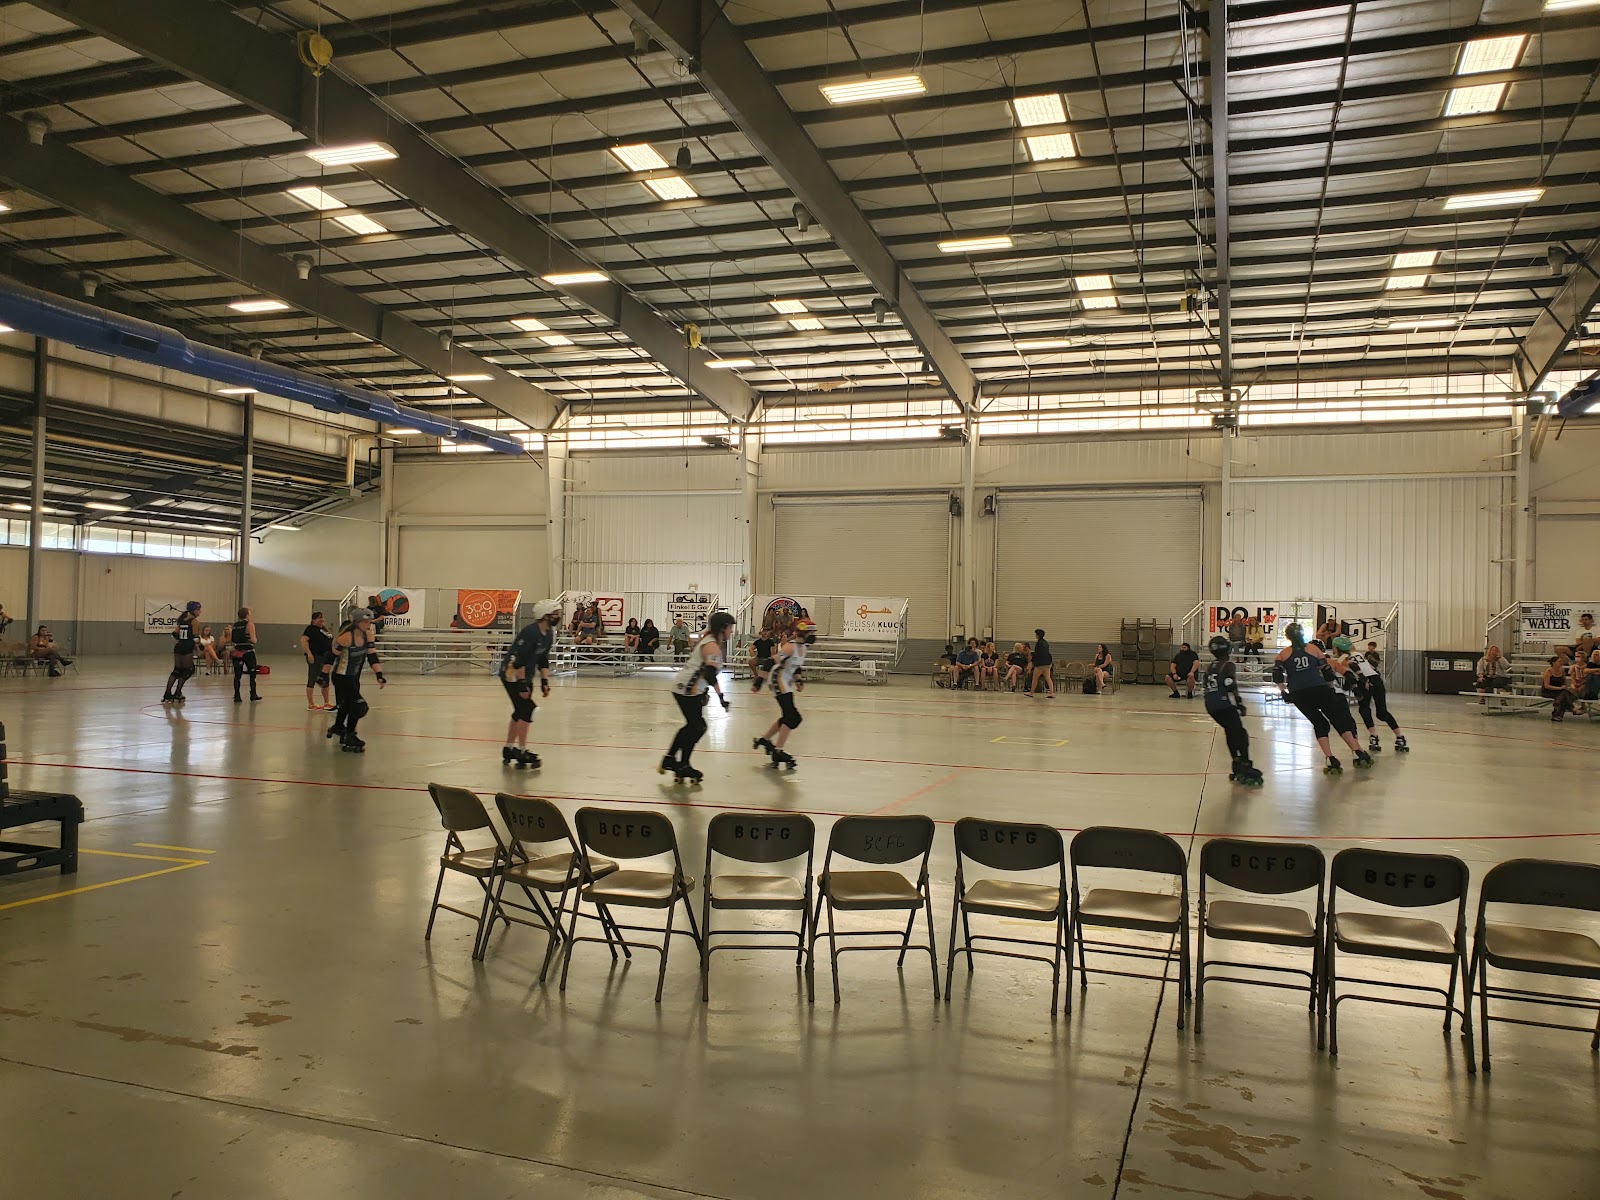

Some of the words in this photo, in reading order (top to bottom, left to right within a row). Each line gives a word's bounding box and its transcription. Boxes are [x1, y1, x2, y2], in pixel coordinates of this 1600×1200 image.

[466, 600, 493, 615] 300
[1216, 606, 1249, 622] DO
[1257, 607, 1274, 623] IT
[1544, 608, 1572, 617] PROOF
[148, 617, 179, 626] UPSLOP
[384, 617, 411, 626] GARDEN
[844, 620, 876, 628] MELISSA
[1528, 618, 1571, 630] WATER
[1293, 656, 1309, 669] 20
[511, 811, 546, 830] BCFG
[598, 821, 653, 839] BCFG
[734, 824, 791, 841] BCFG
[978, 828, 1038, 845] BCFG
[863, 834, 906, 853] BCFG
[1230, 852, 1297, 873] BCFG
[1364, 868, 1437, 889] BCFG
